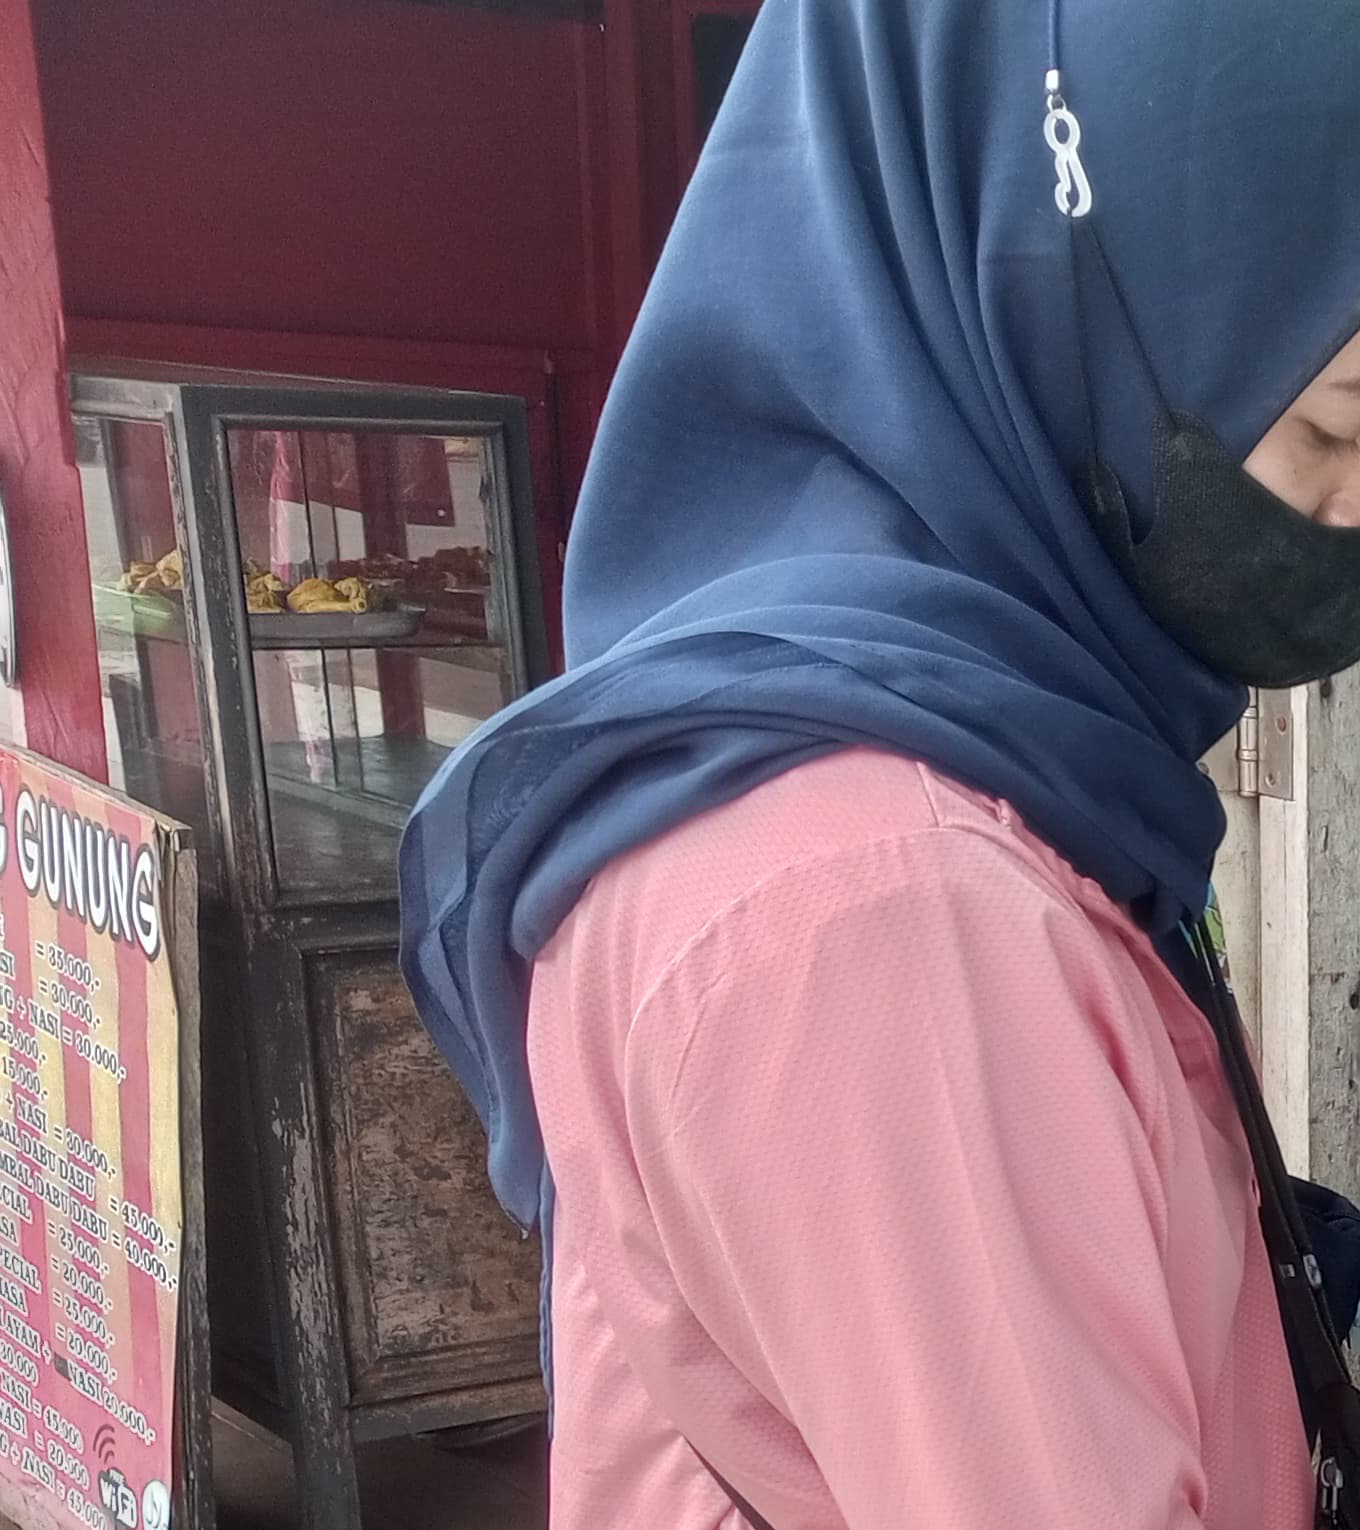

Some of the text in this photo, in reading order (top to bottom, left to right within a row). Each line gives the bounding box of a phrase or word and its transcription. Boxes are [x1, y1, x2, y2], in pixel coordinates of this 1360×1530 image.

[16, 786, 160, 960] GUNUNG
[29, 1001, 60, 1041] NASI
[16, 1095, 48, 1136] NASI
[22, 1131, 56, 1172] DABU
[58, 1157, 95, 1198] DABU
[35, 1170, 69, 1215] DABU
[71, 1199, 108, 1242] DABU
[6, 1311, 41, 1358] AYAM
